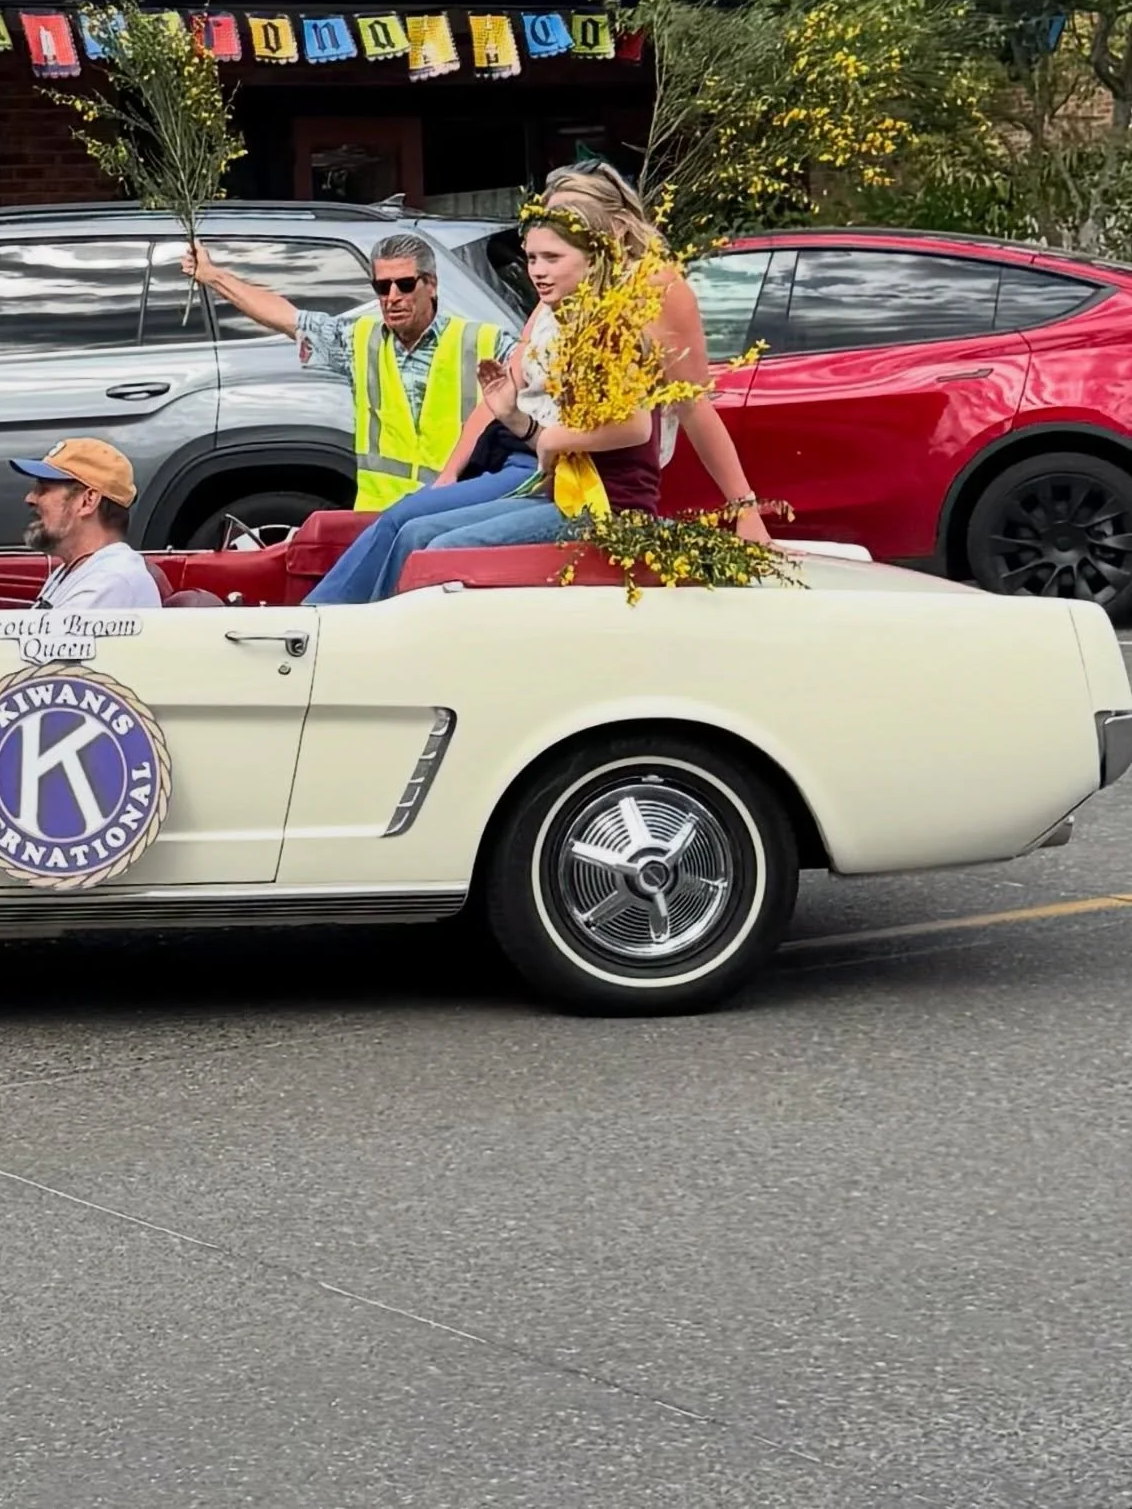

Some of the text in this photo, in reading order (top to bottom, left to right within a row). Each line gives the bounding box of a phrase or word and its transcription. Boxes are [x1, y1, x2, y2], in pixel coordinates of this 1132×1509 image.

[63, 613, 136, 636] Broom
[23, 638, 92, 664] Queen
[15, 710, 108, 840] K
